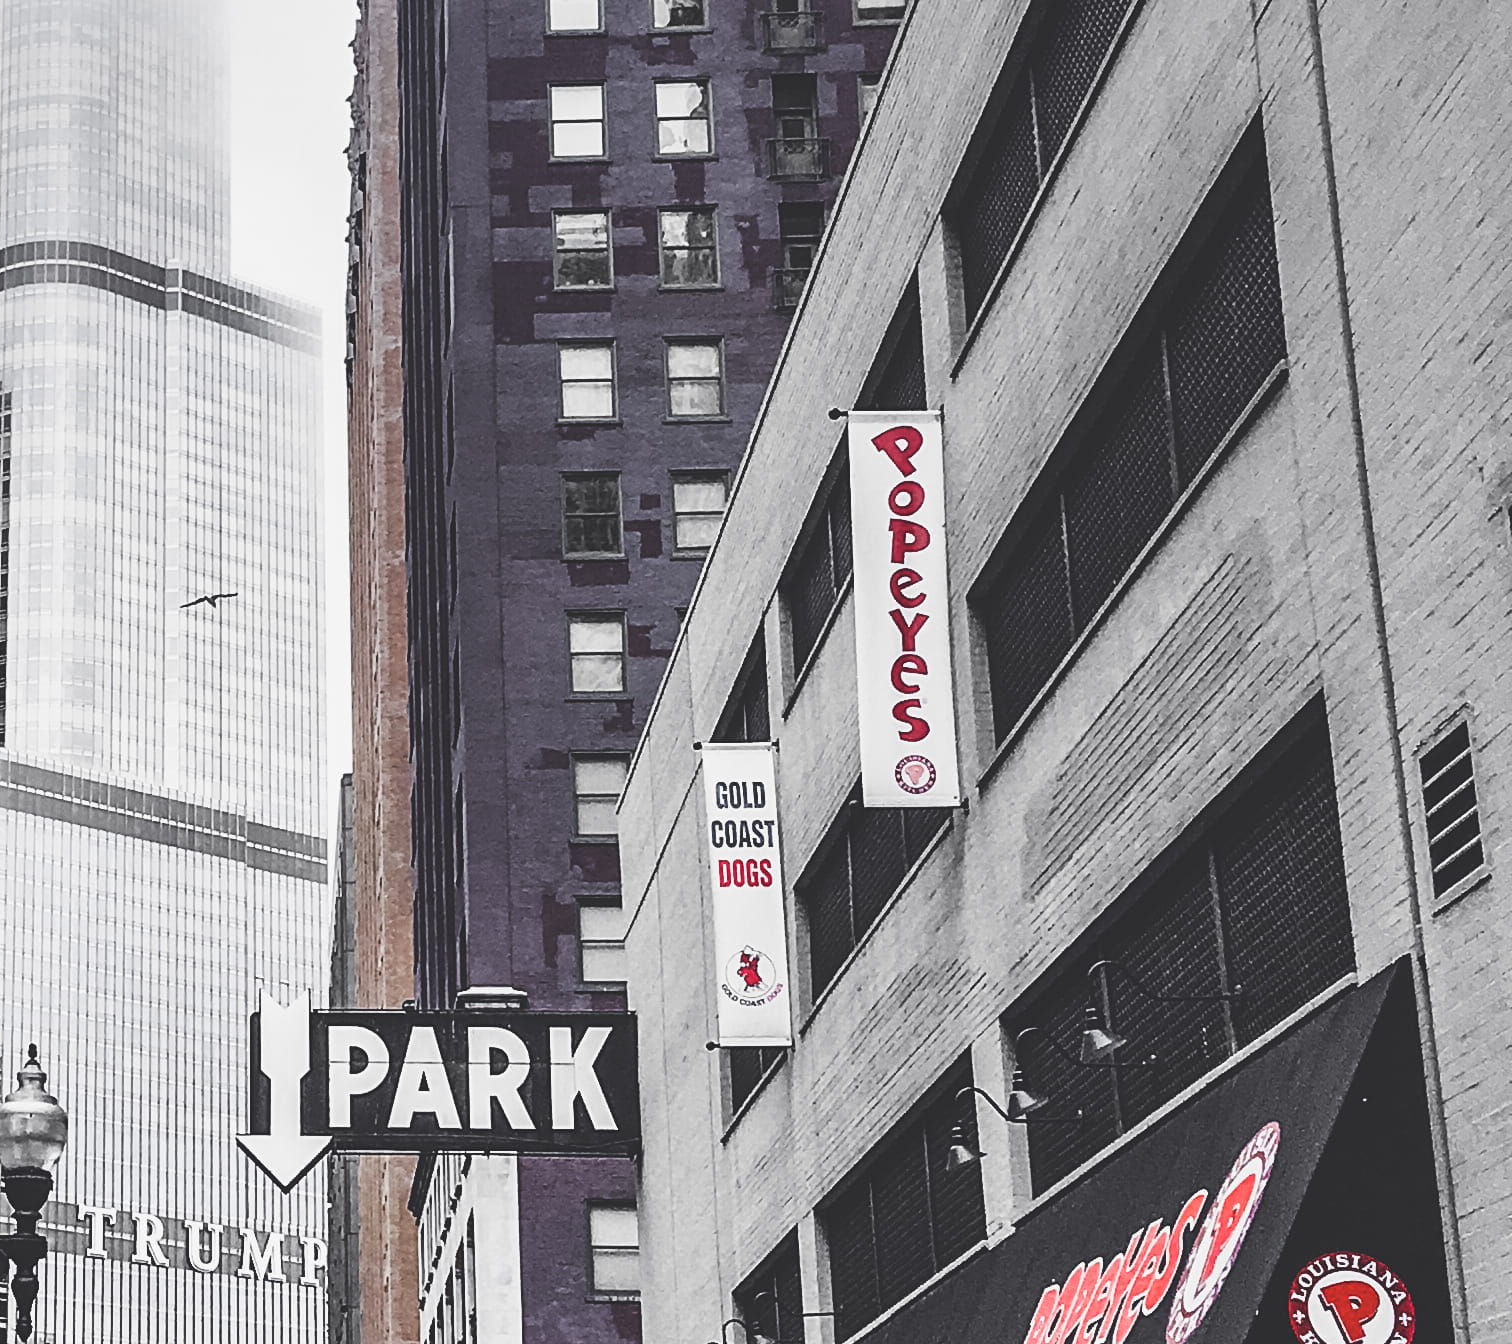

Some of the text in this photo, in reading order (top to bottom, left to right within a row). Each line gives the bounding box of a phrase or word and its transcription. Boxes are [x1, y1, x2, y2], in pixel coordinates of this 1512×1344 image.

[715, 781, 766, 809] GOLD
[711, 820, 775, 848] COAST
[718, 858, 773, 888] DOGS
[327, 1025, 619, 1132] PARK
[77, 1203, 328, 1288] TRUMP
[1291, 1254, 1407, 1306] LOUISIANA
